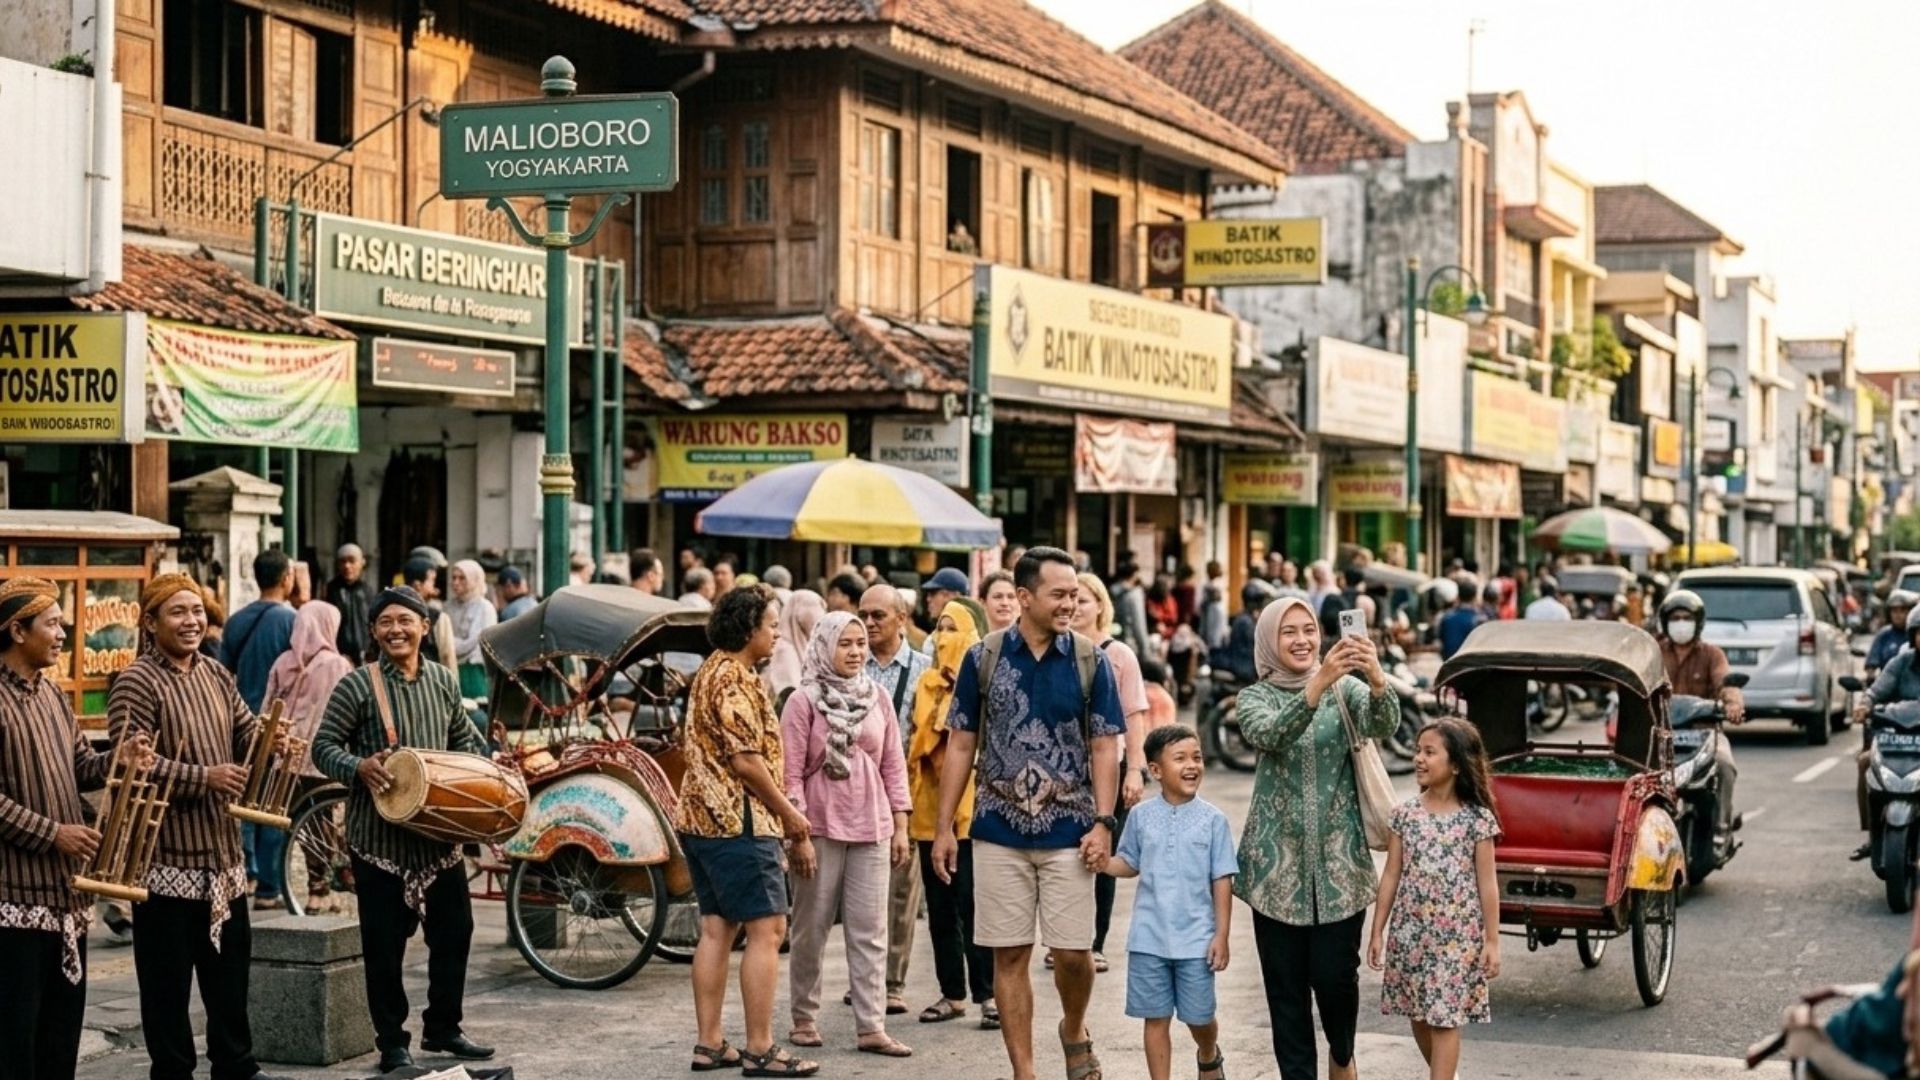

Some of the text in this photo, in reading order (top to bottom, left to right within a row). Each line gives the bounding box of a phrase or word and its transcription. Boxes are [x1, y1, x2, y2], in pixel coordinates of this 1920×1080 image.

[464, 118, 650, 153] MALIOBORO
[485, 155, 629, 178] YOGYAKARTA
[1225, 225, 1282, 244] BATIK
[336, 231, 415, 280] PASAR
[1043, 325, 1218, 394] BATIK WINOTOSASTRO
[662, 420, 842, 446] WARUNG BAKSO
